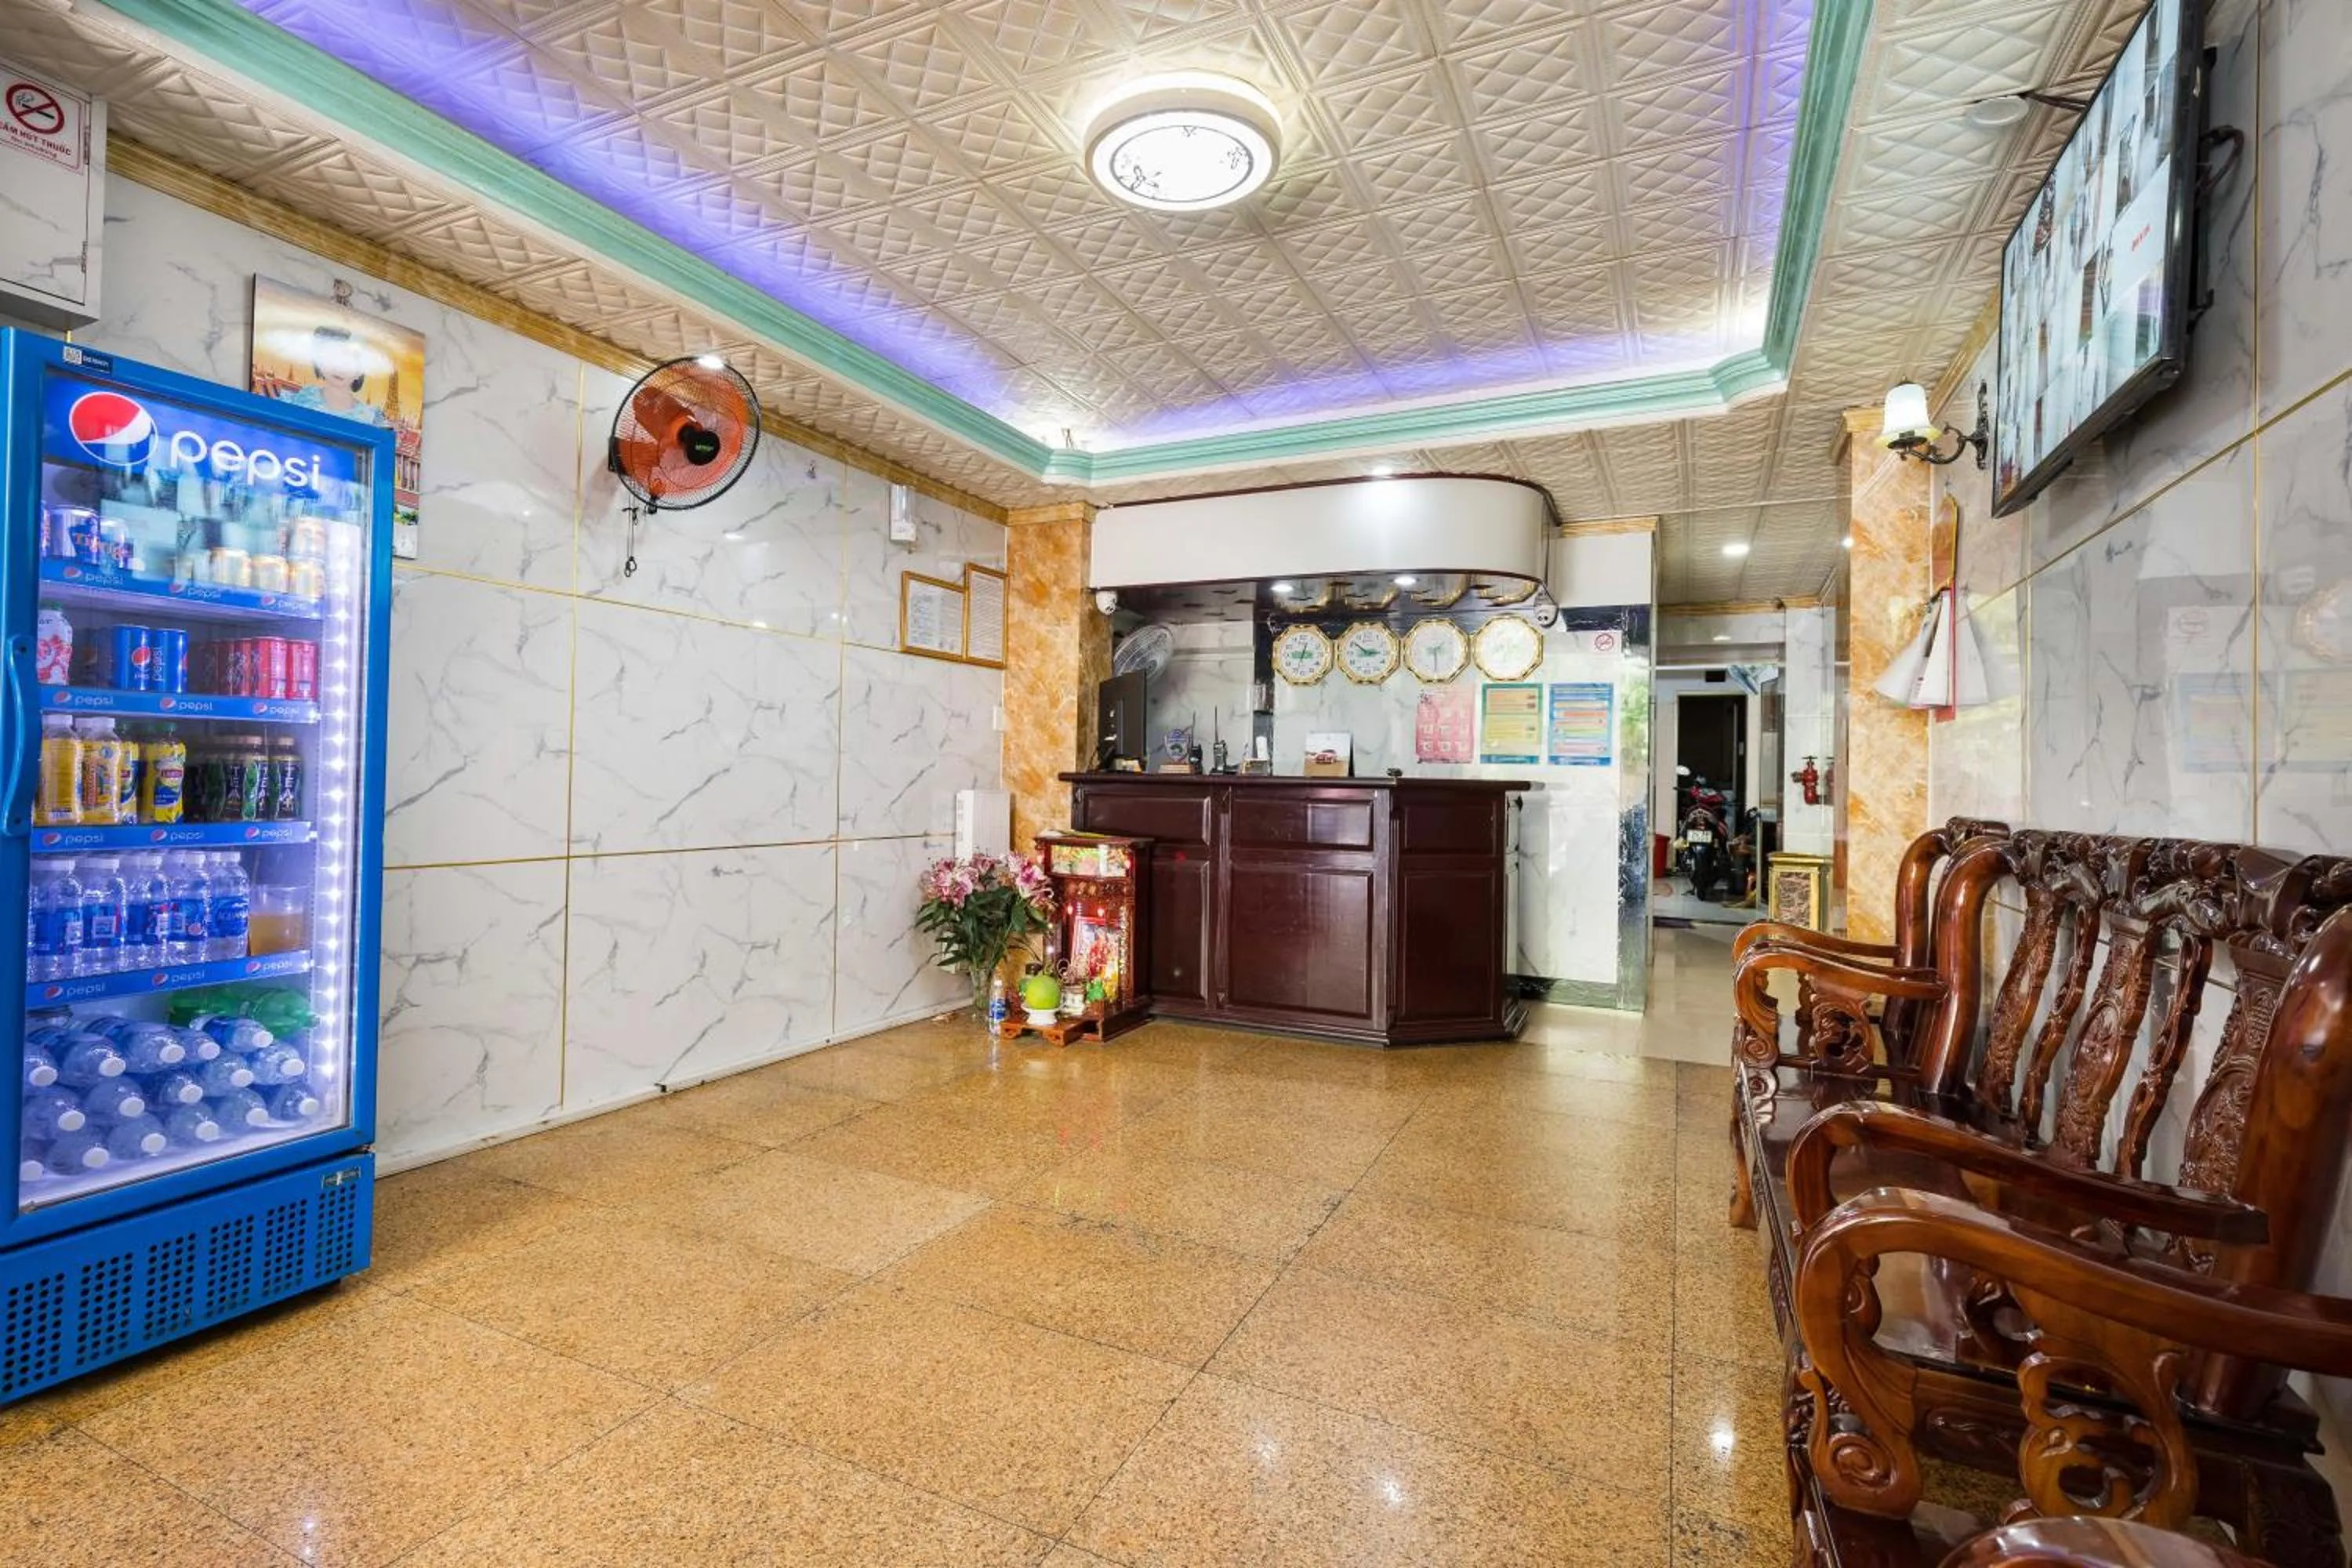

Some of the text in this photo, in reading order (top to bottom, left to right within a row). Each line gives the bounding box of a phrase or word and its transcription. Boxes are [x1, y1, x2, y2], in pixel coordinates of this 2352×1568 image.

[171, 430, 321, 490] pepsi
[85, 572, 123, 586] pepsi
[153, 647, 166, 681] pepsi
[74, 695, 114, 706] pepsi
[179, 701, 214, 712] pepsi
[64, 833, 103, 846] pepsi
[170, 830, 205, 841] pepsi
[260, 828, 292, 839] pepsi
[171, 970, 205, 983] pepsi
[67, 982, 106, 998] pepsi
